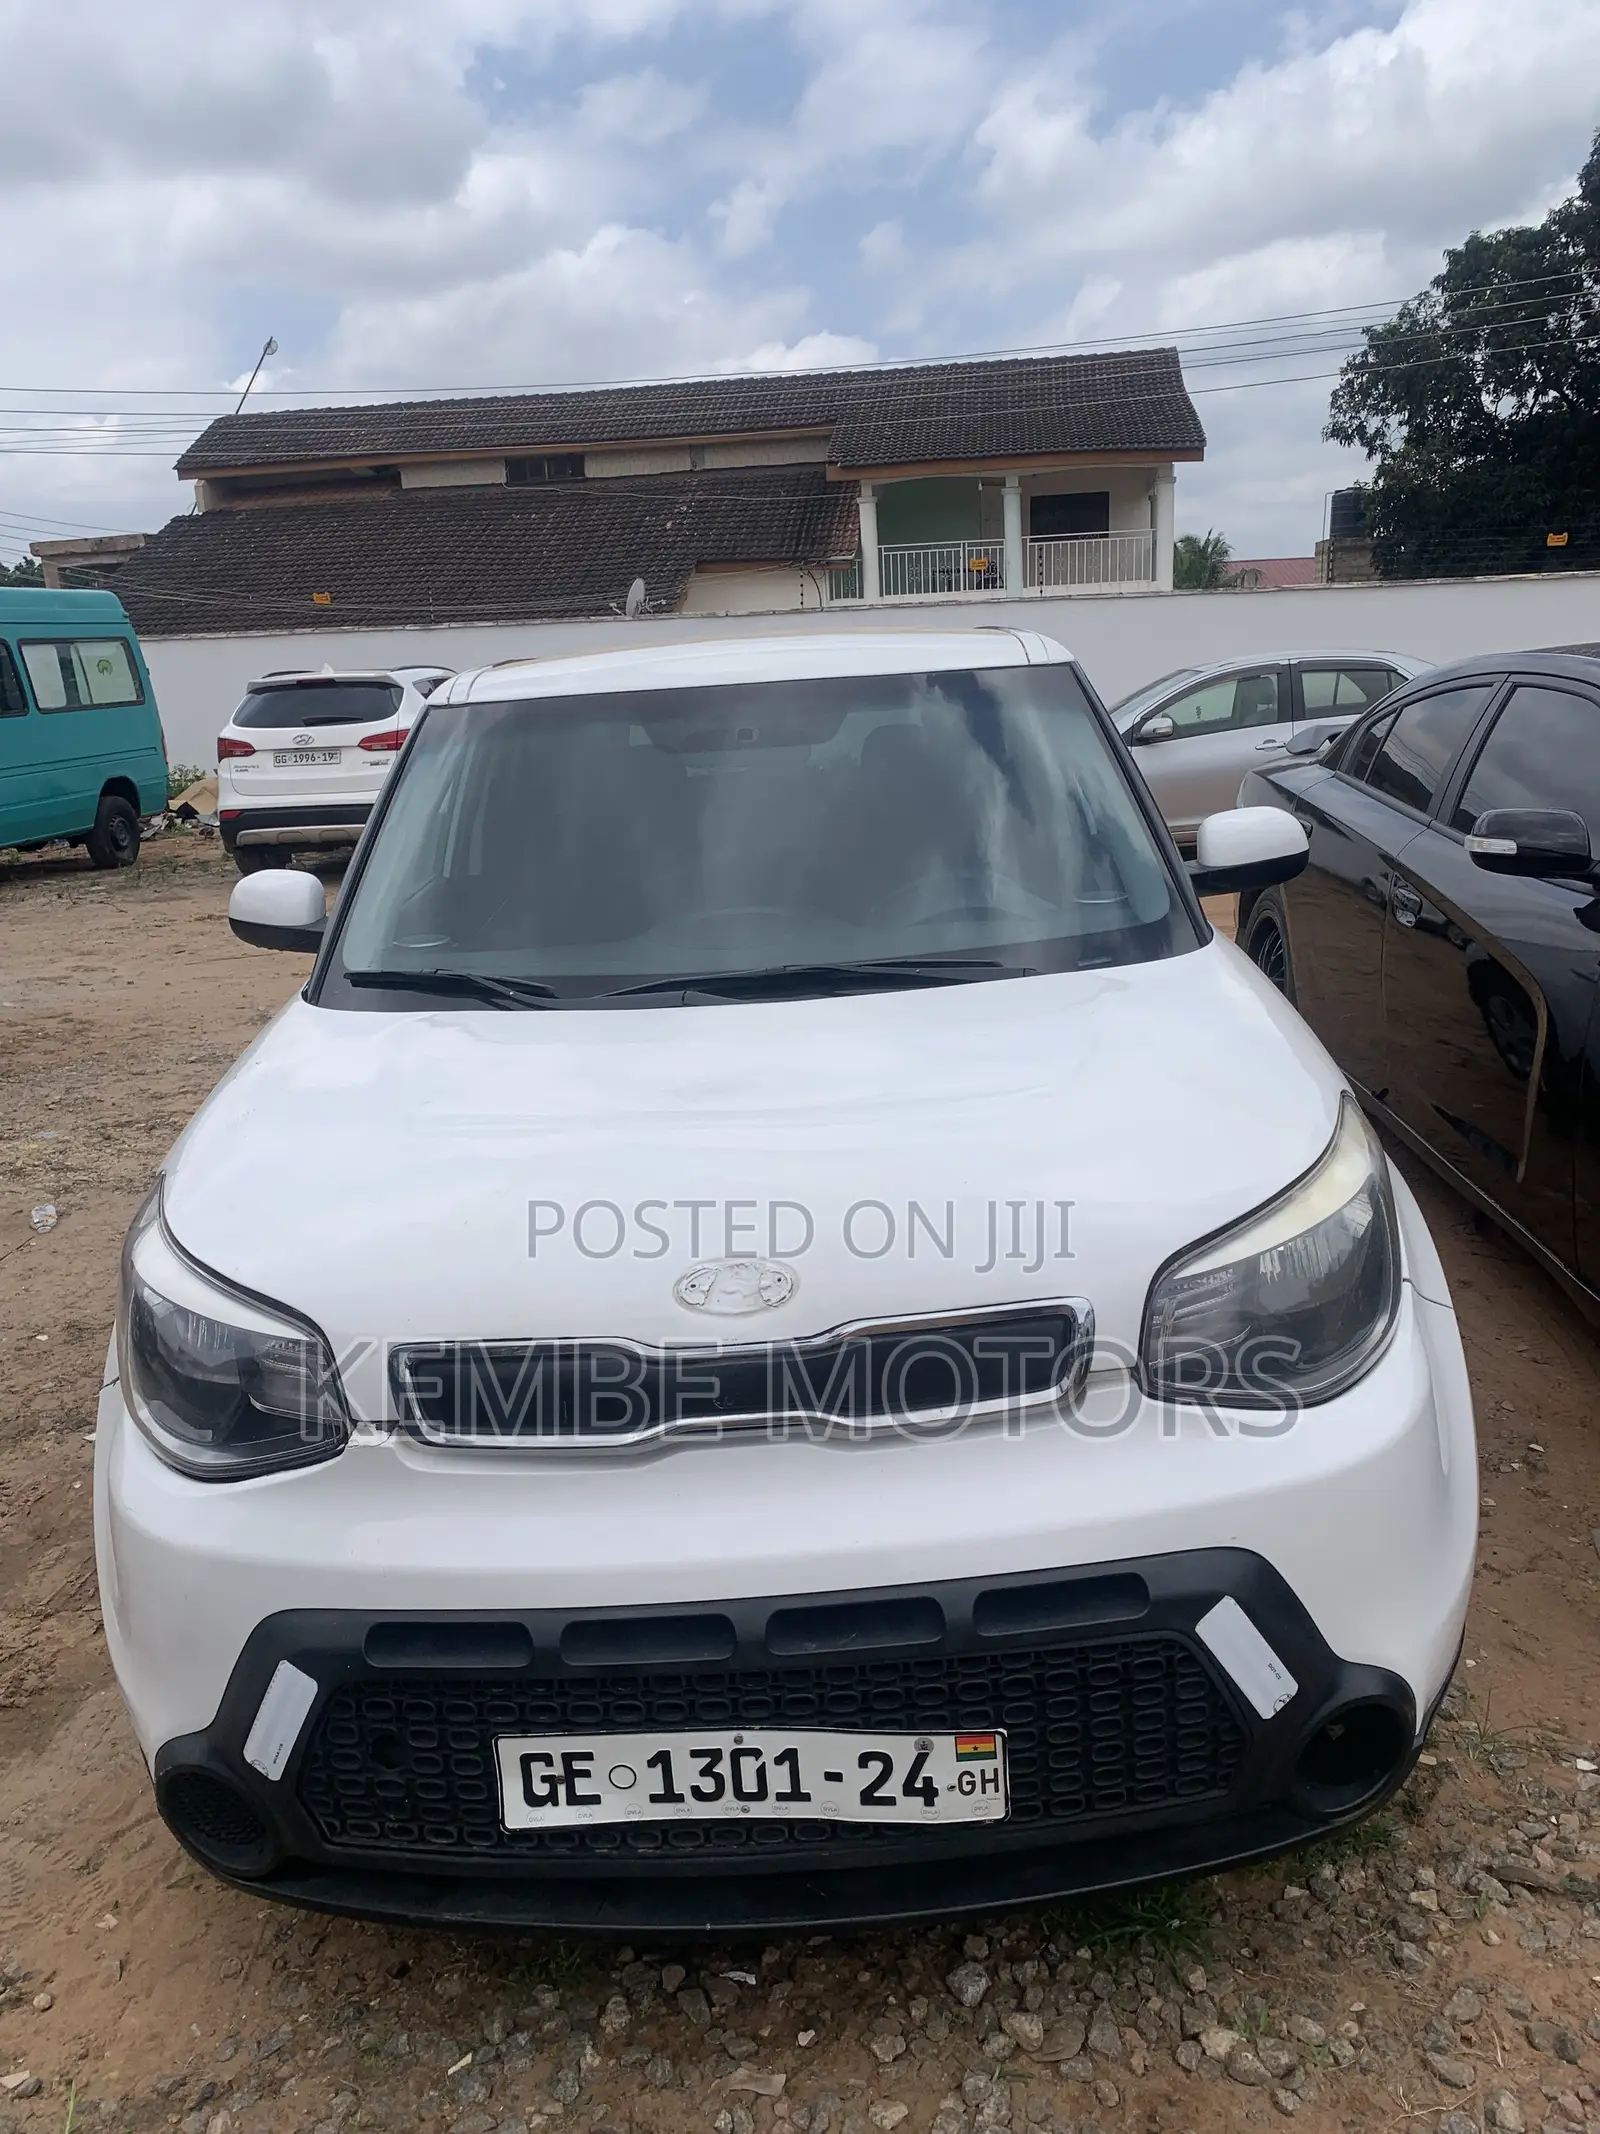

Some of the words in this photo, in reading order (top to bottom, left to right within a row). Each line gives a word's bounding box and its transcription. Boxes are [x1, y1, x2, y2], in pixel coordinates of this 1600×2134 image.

[275, 755, 287, 764] GG
[519, 1751, 602, 1807] GE
[957, 1768, 1000, 1796] GH
